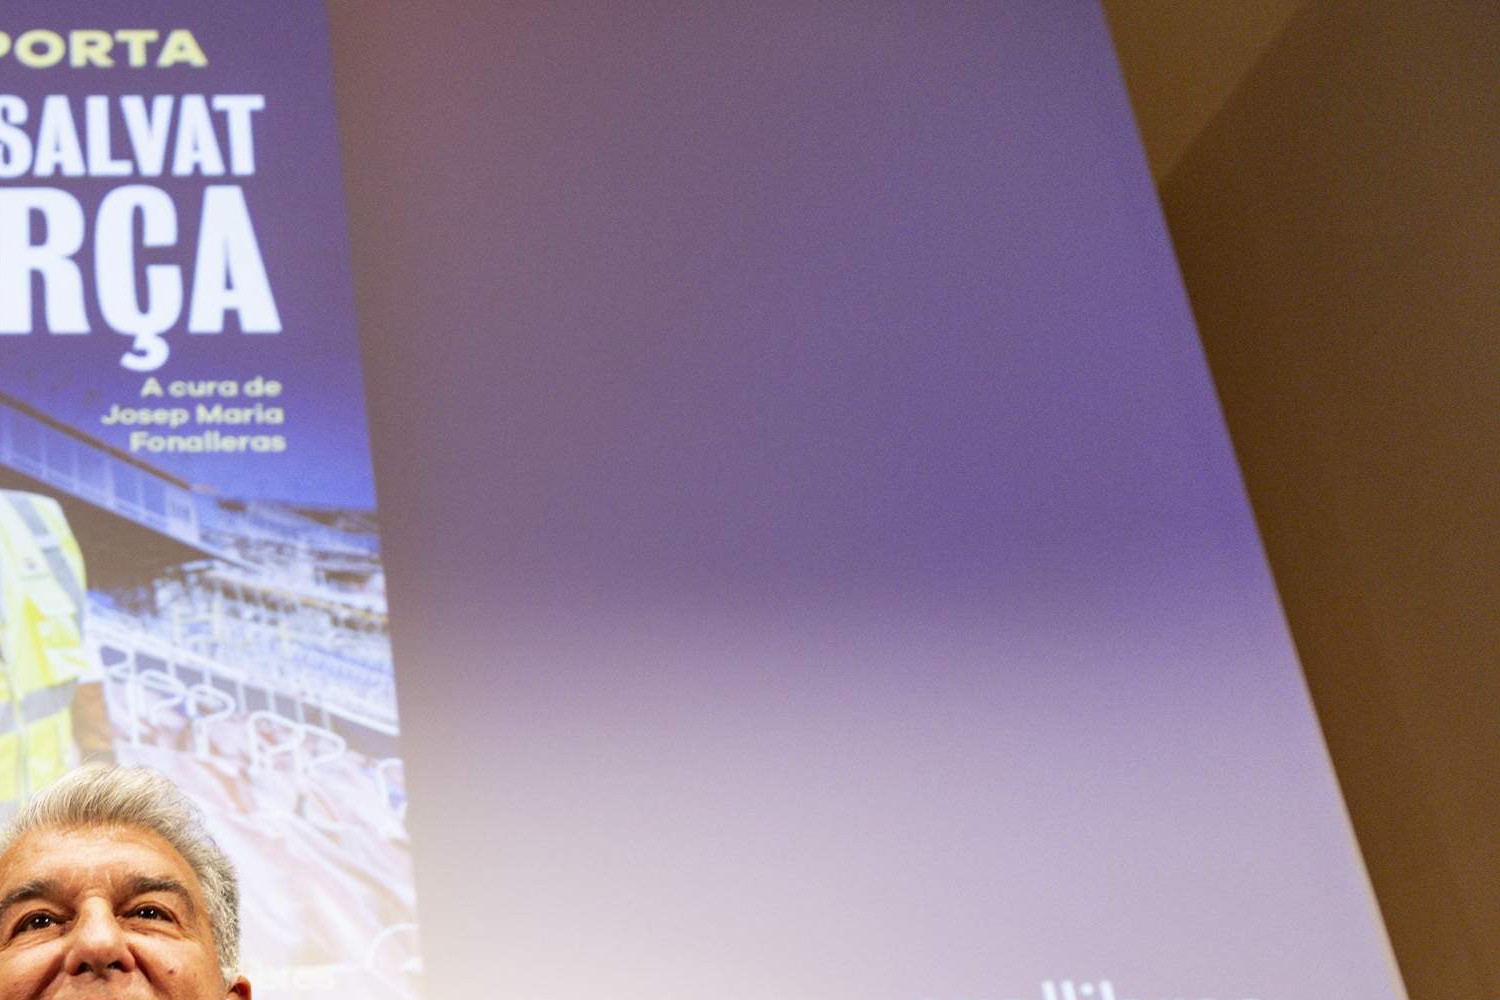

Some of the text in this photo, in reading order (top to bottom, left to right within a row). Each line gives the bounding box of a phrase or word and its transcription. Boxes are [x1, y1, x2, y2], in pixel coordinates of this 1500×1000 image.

[141, 376, 282, 397] A cura de
[101, 403, 285, 428] Josep Maria
[130, 431, 287, 453] Fonalleras
